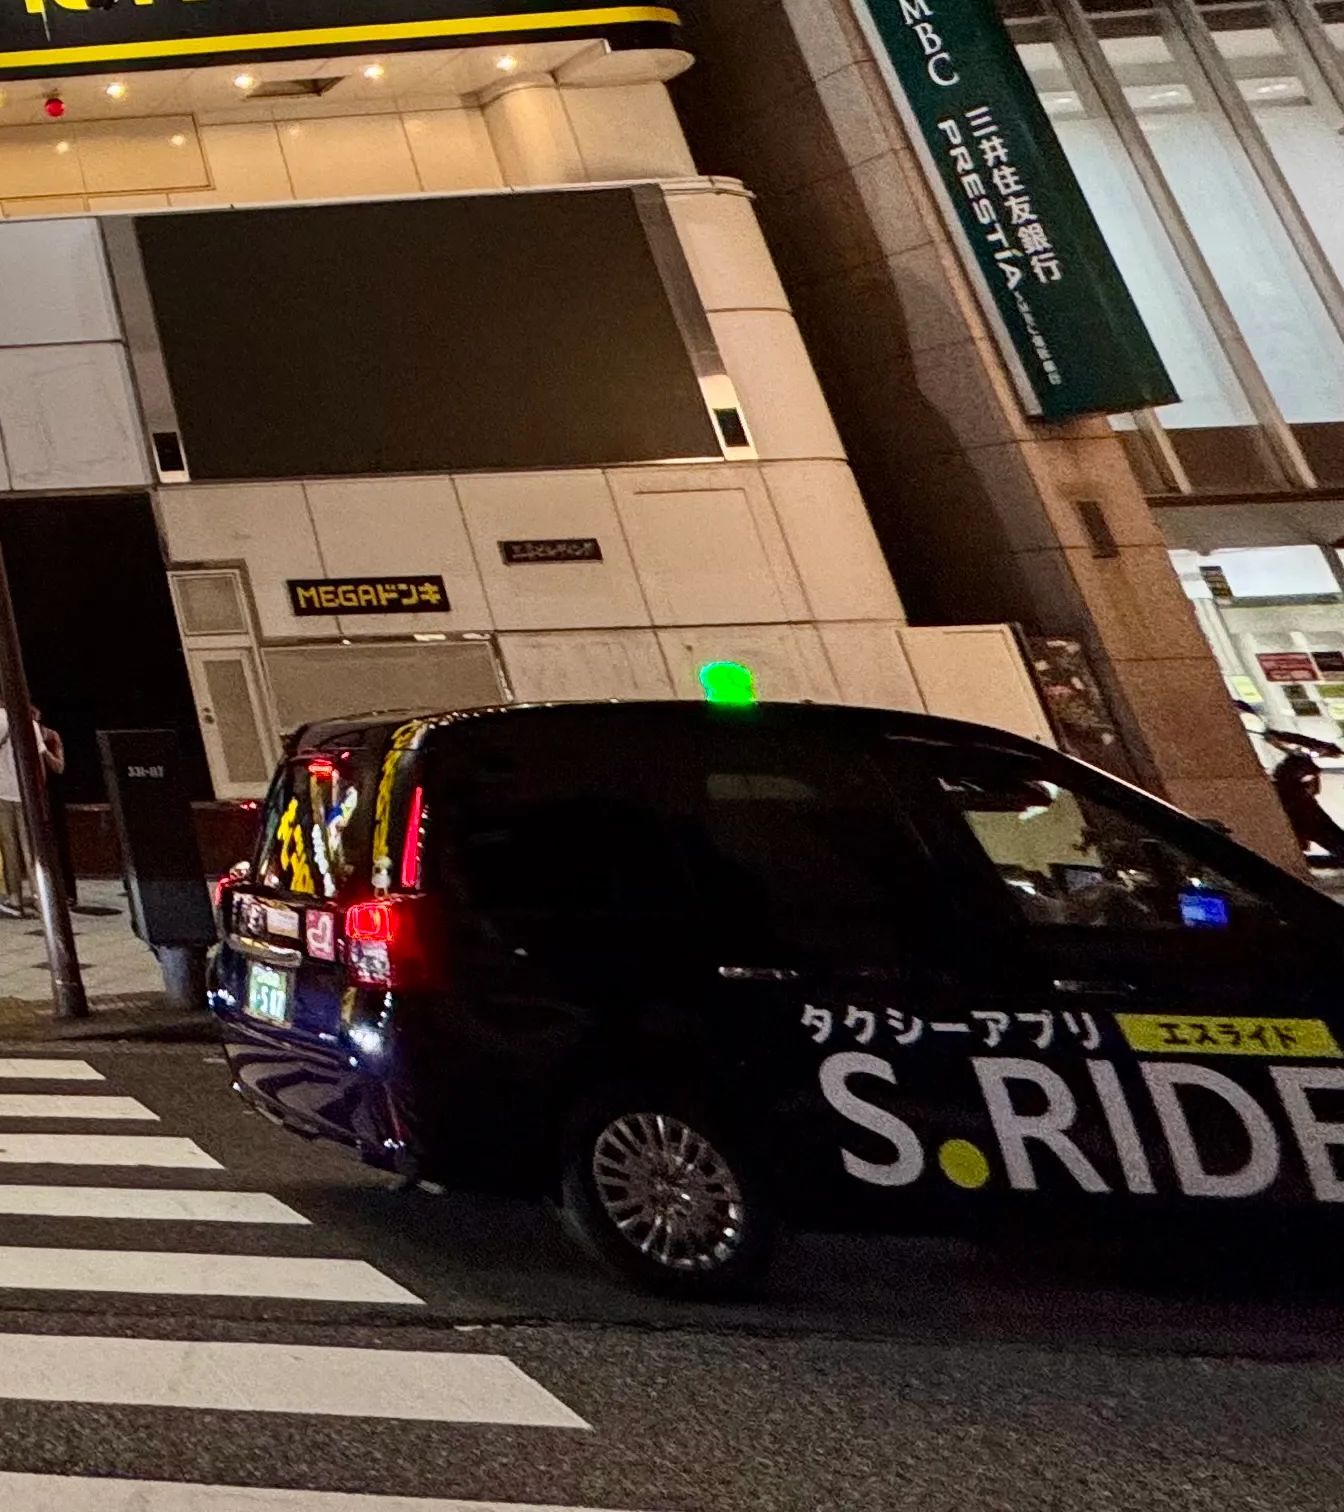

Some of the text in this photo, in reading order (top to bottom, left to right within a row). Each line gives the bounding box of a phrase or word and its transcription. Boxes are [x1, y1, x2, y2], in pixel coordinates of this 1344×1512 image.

[965, 105, 1062, 285] 三井住友銀行
[296, 582, 442, 609] MEGAドンキ
[800, 1002, 1103, 1050] タクシーアプリ
[1158, 1020, 1305, 1050] エスライド
[817, 1050, 1344, 1203] S.RIDE
